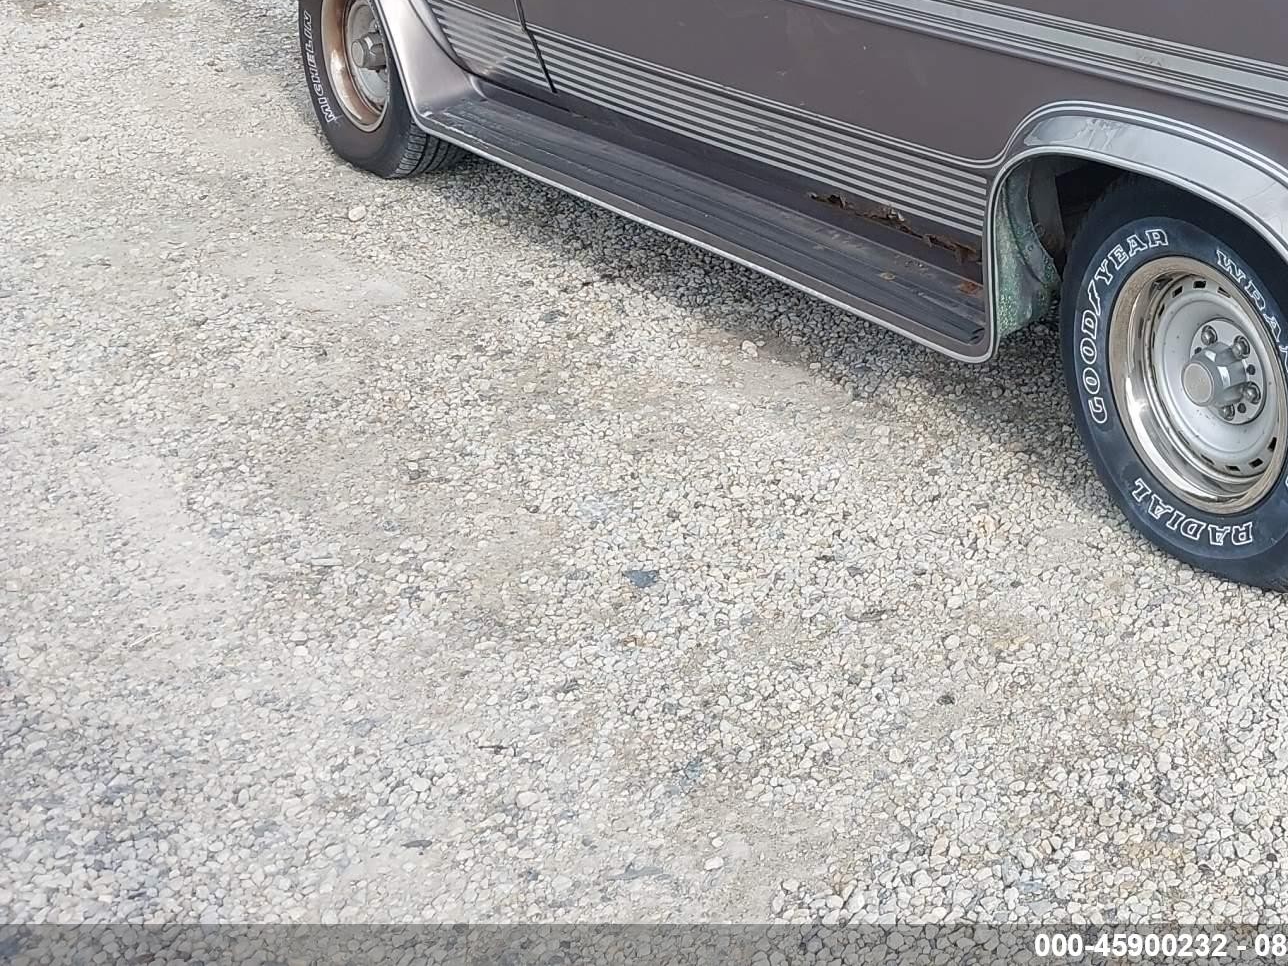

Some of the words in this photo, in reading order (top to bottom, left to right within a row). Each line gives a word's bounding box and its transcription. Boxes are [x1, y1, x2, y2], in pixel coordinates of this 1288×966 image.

[304, 10, 336, 123] MICHELIN
[1081, 229, 1168, 424] GOODYEAR
[1132, 478, 1254, 546] RADIAL
